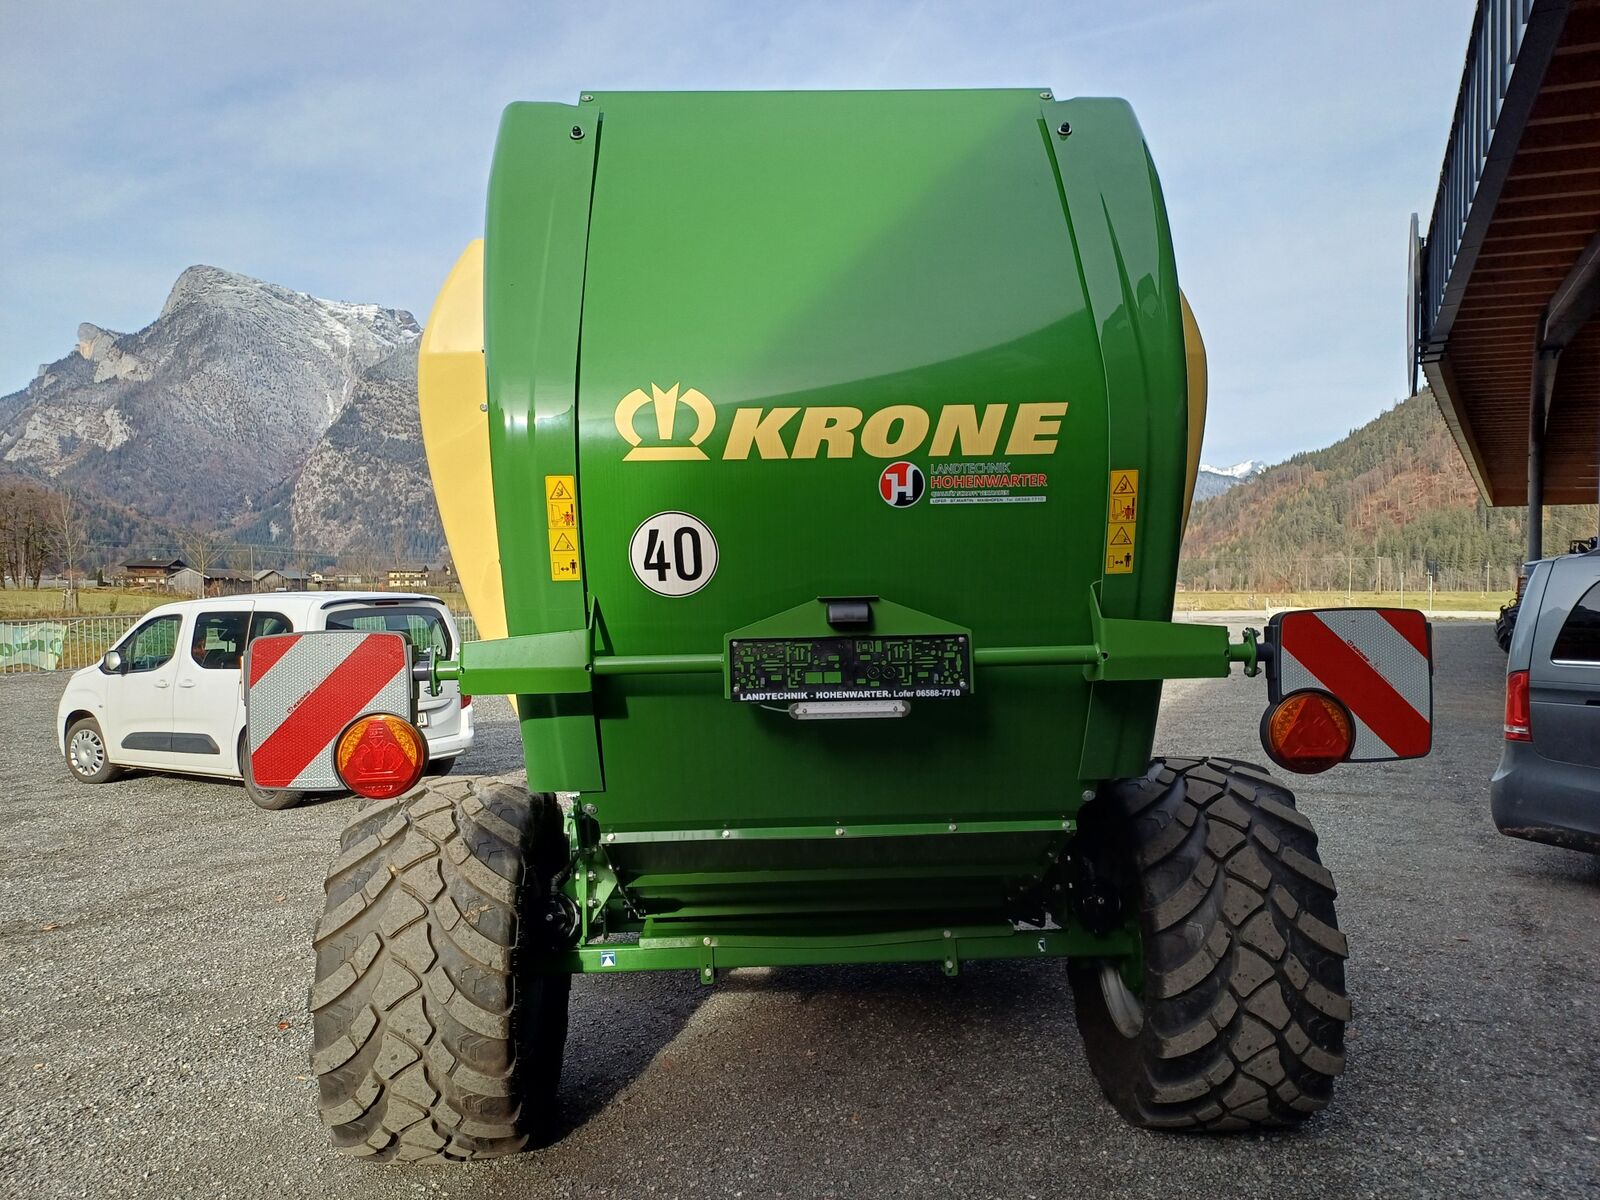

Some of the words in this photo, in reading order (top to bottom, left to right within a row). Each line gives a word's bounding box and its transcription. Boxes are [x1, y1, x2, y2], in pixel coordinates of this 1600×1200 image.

[721, 402, 1069, 460] KRONE
[930, 462, 1011, 475] LANDTECHNIK
[930, 473, 1048, 489] HOHENWARTER
[643, 526, 703, 582] 40
[740, 691, 808, 701] LANDTECHNIK
[893, 689, 915, 698] Lofer
[916, 689, 961, 697] 06588-7710
